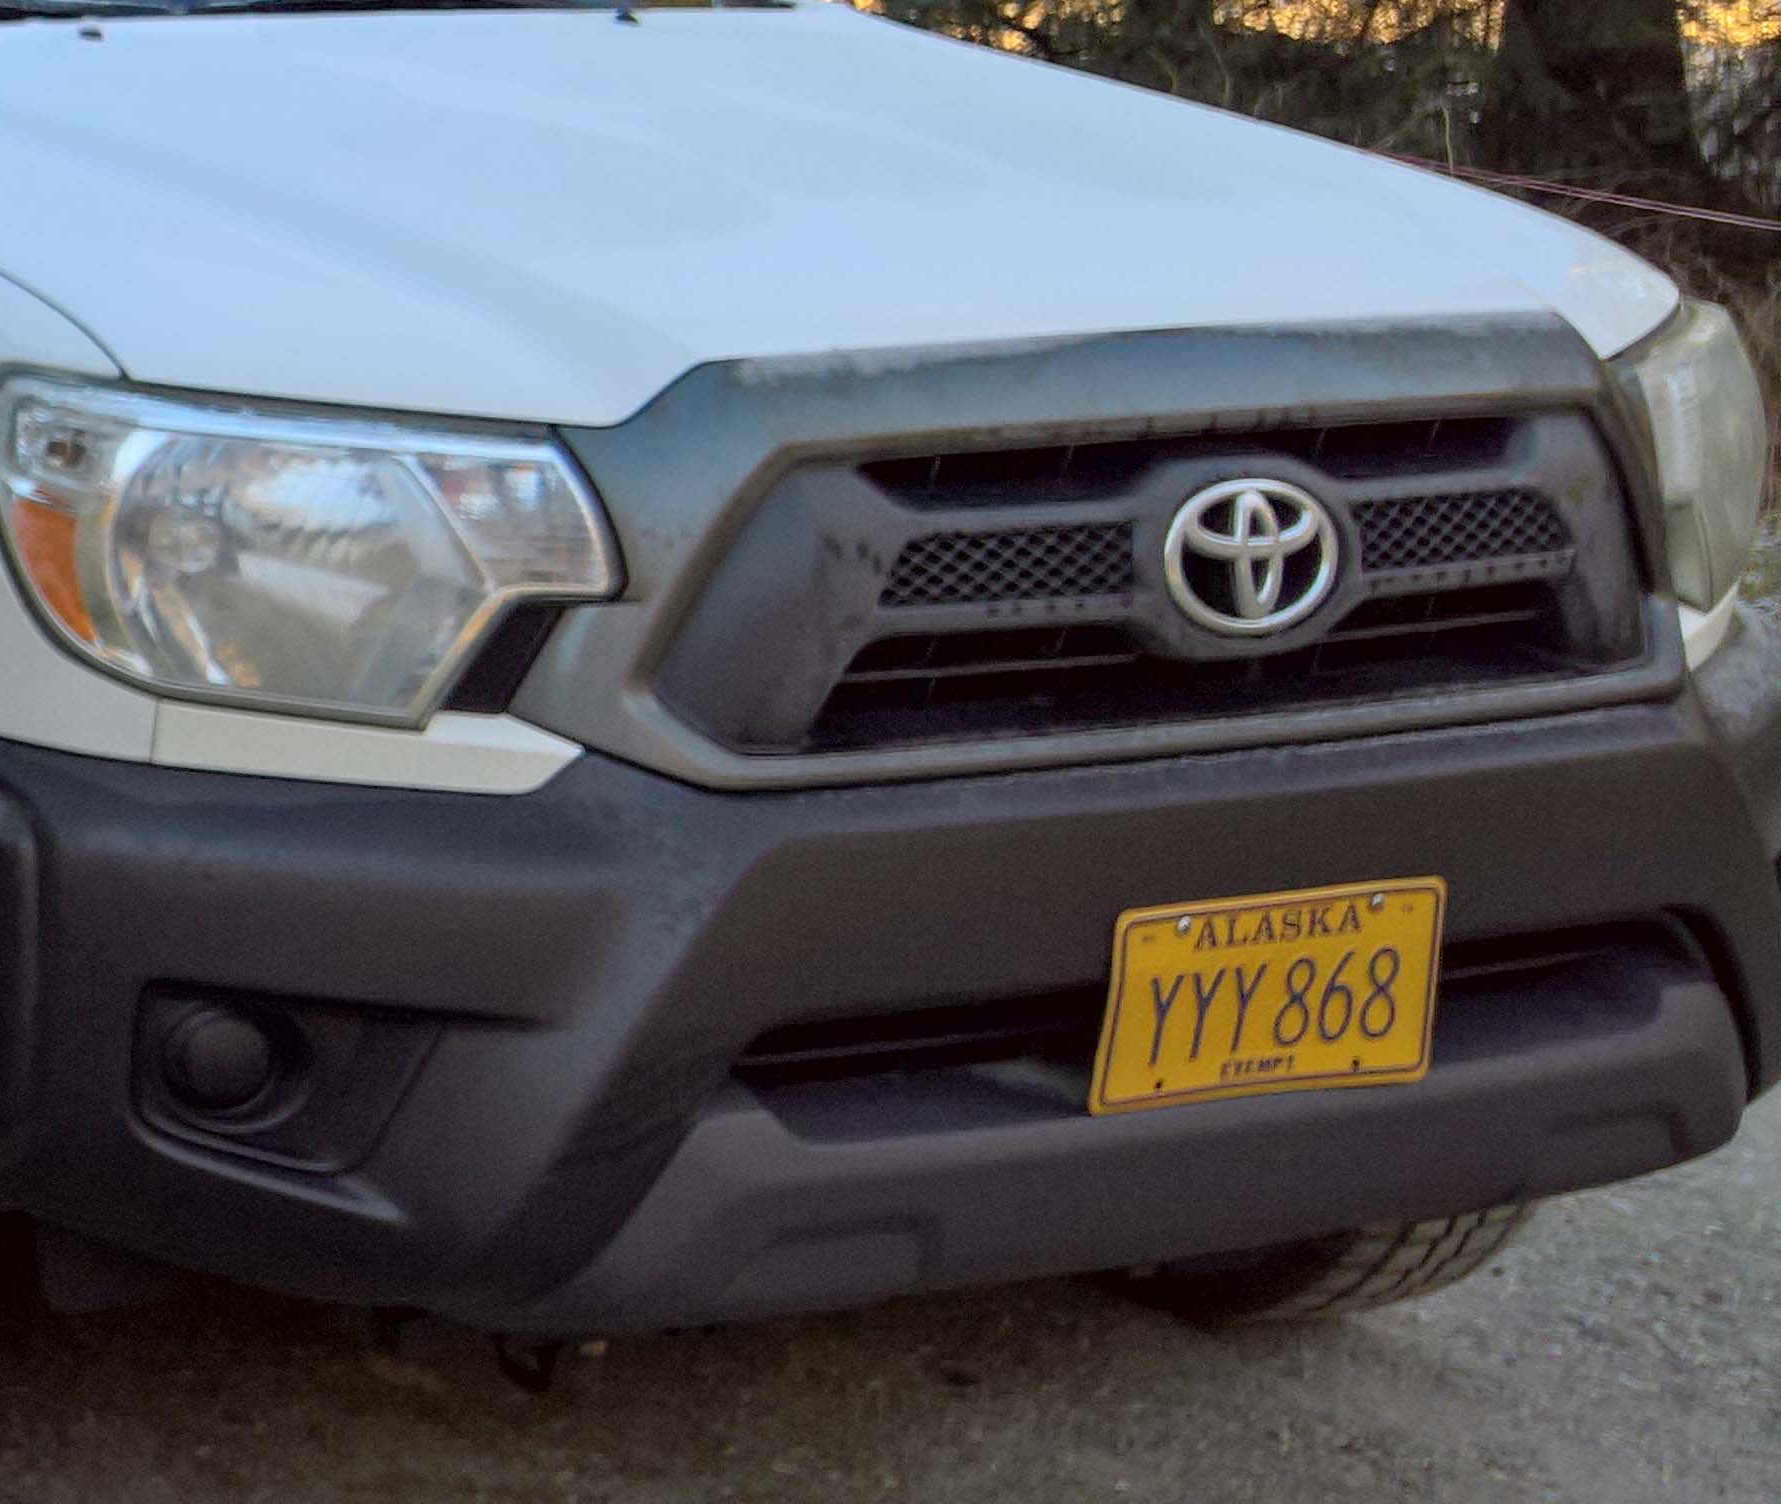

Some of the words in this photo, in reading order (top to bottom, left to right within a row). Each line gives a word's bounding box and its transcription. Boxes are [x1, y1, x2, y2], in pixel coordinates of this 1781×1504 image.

[1193, 903, 1363, 952] ALASKA
[1148, 962, 1269, 1067] YYY
[1272, 946, 1401, 1046] 868
